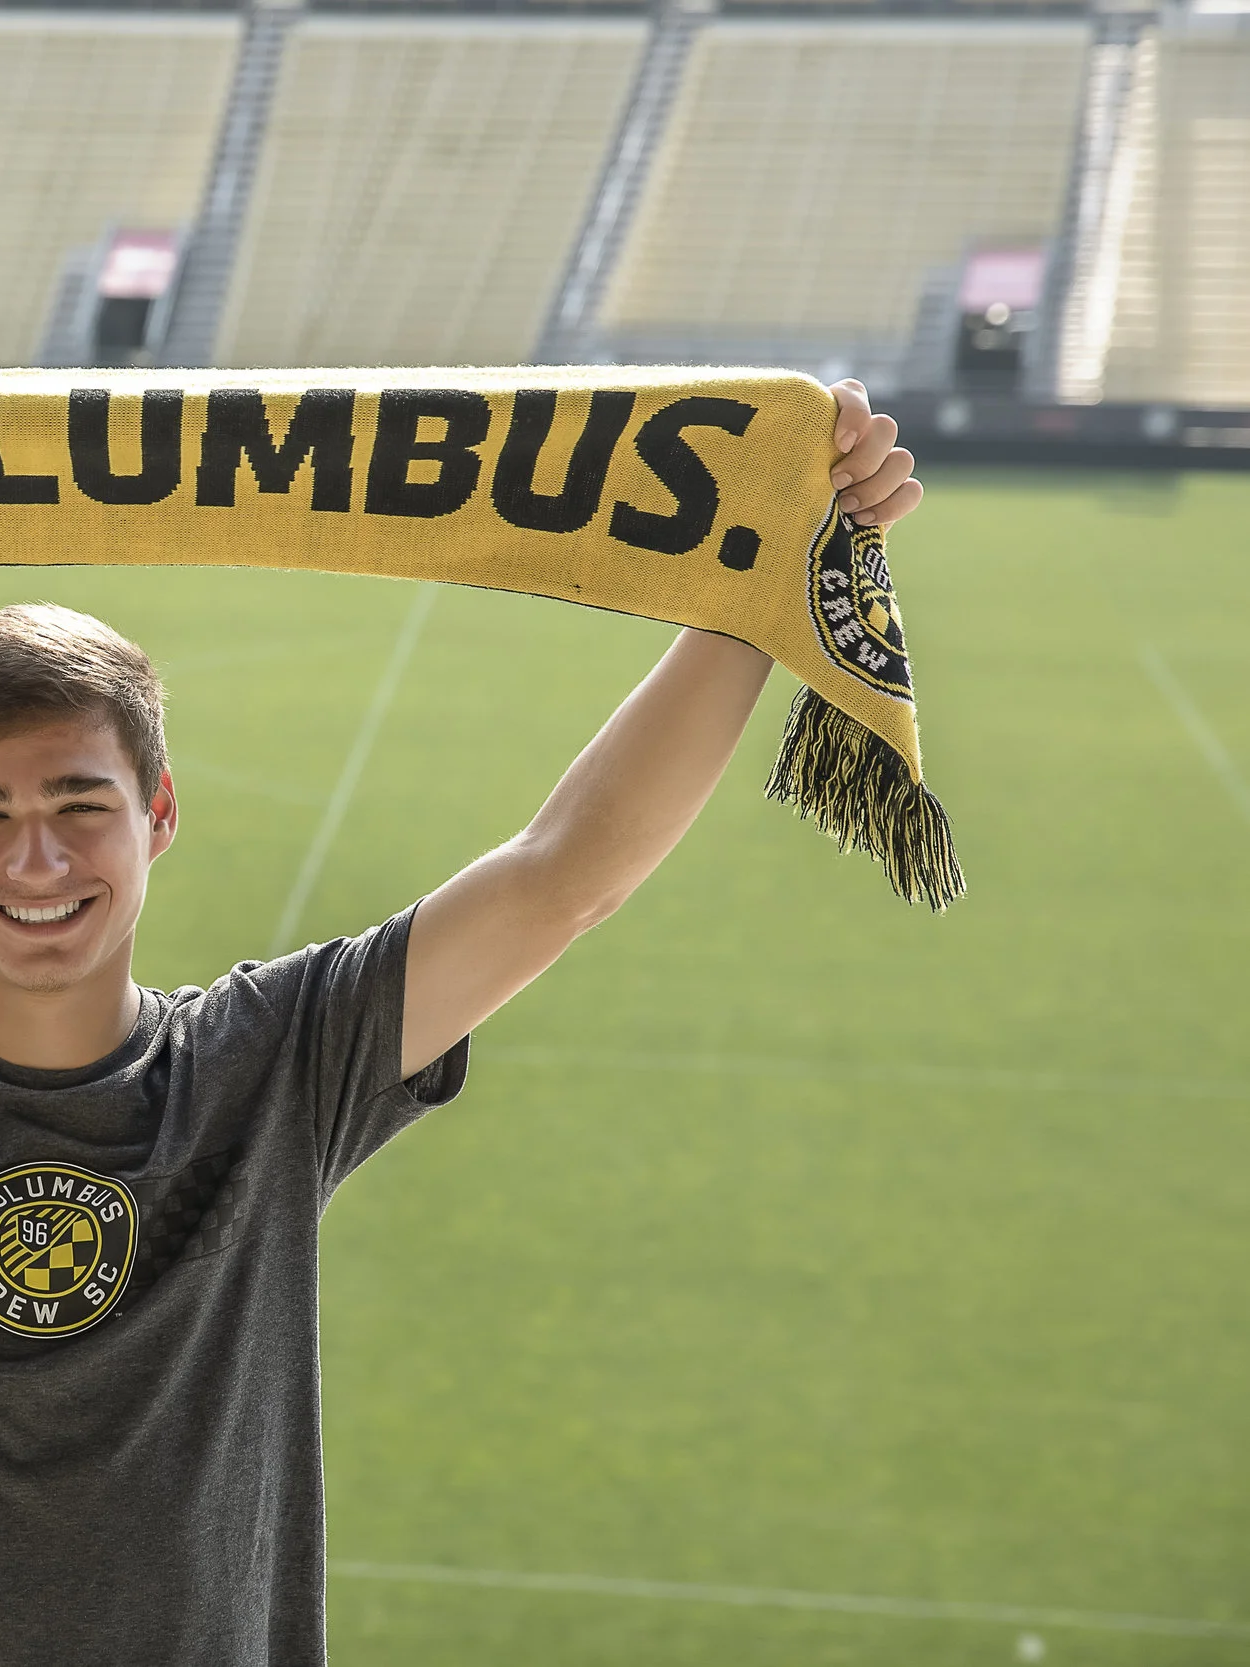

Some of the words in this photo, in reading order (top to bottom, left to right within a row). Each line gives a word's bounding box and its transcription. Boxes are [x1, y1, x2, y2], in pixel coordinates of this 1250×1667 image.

[821, 567, 890, 673] CREW
[22, 1219, 48, 1246] 96
[83, 1262, 118, 1306] SC
